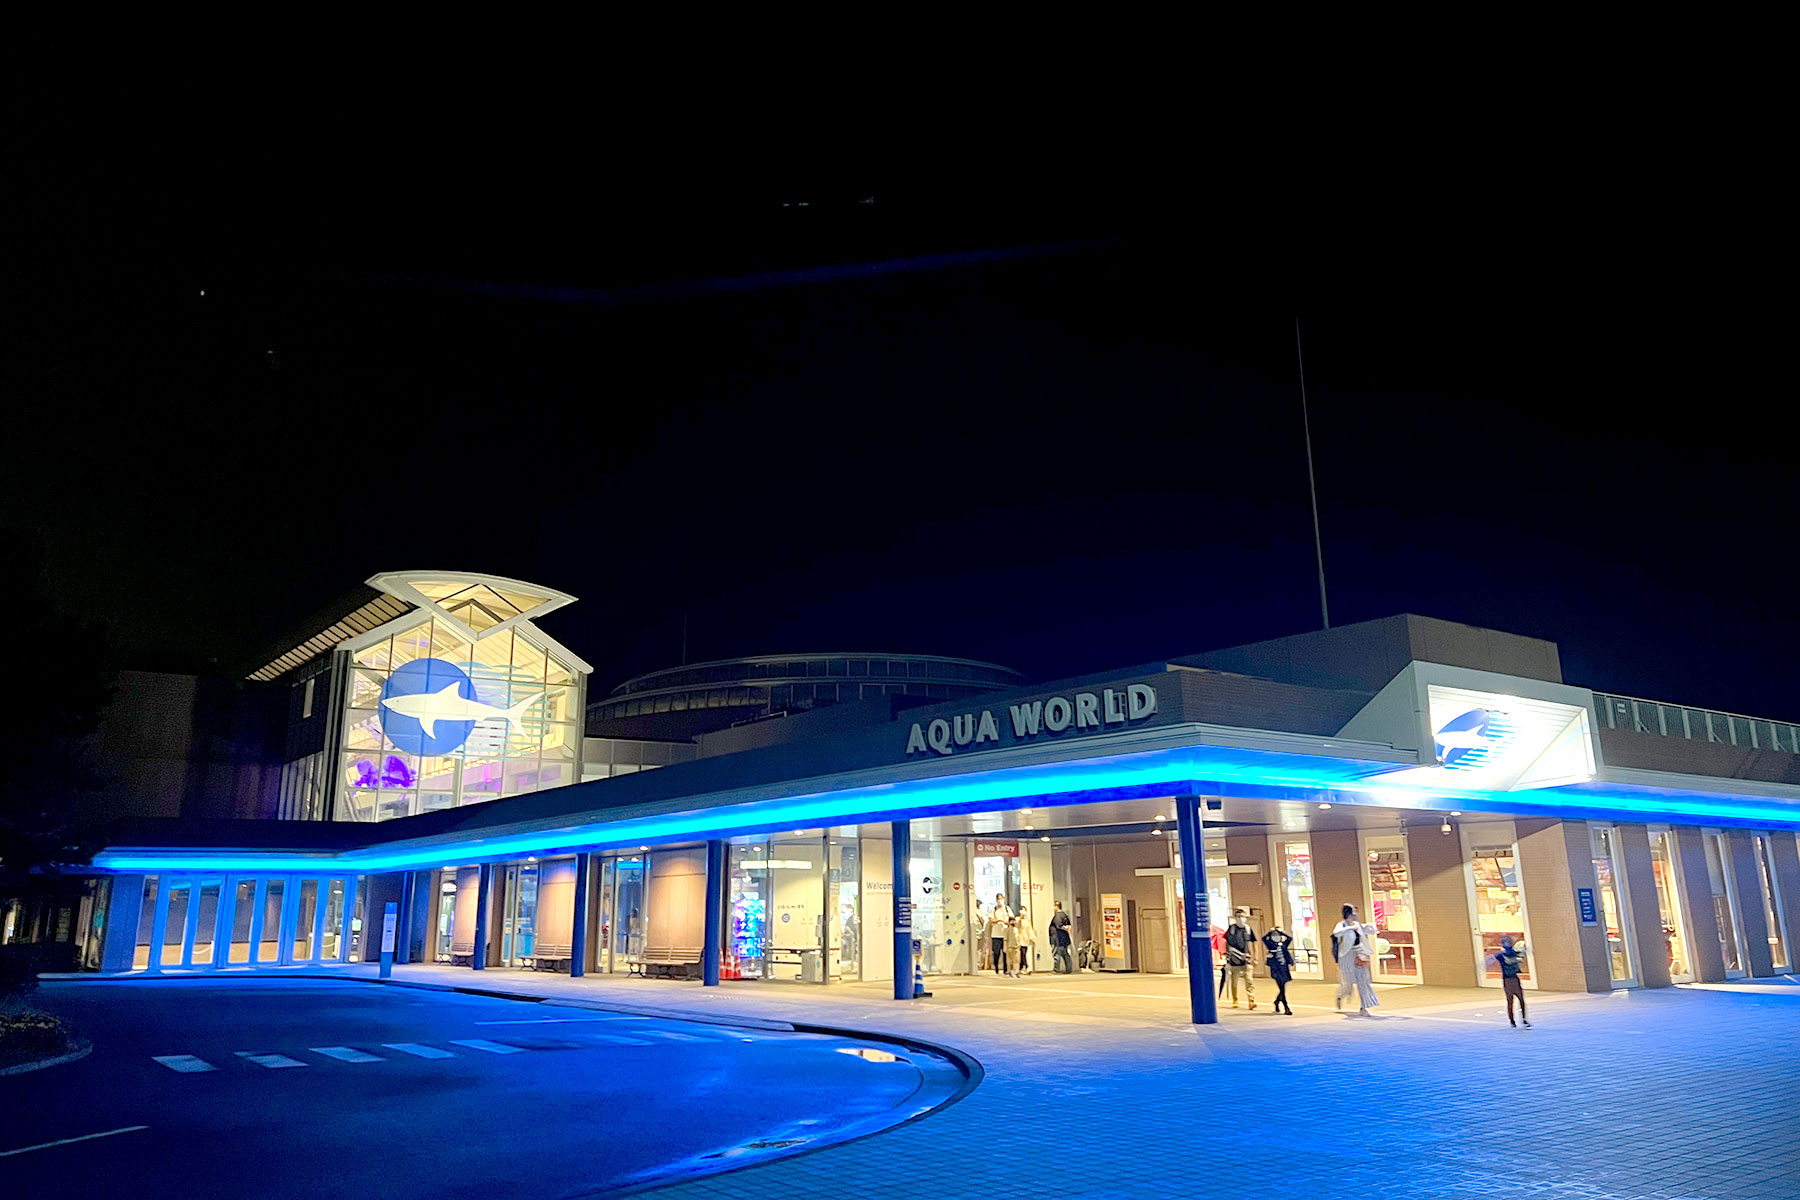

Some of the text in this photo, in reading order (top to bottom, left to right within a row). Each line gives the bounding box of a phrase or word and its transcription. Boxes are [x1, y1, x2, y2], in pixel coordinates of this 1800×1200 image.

[906, 684, 1156, 755] AQUA WORLD
[984, 844, 1016, 853] No Entry
[1022, 882, 1044, 891] Etry
